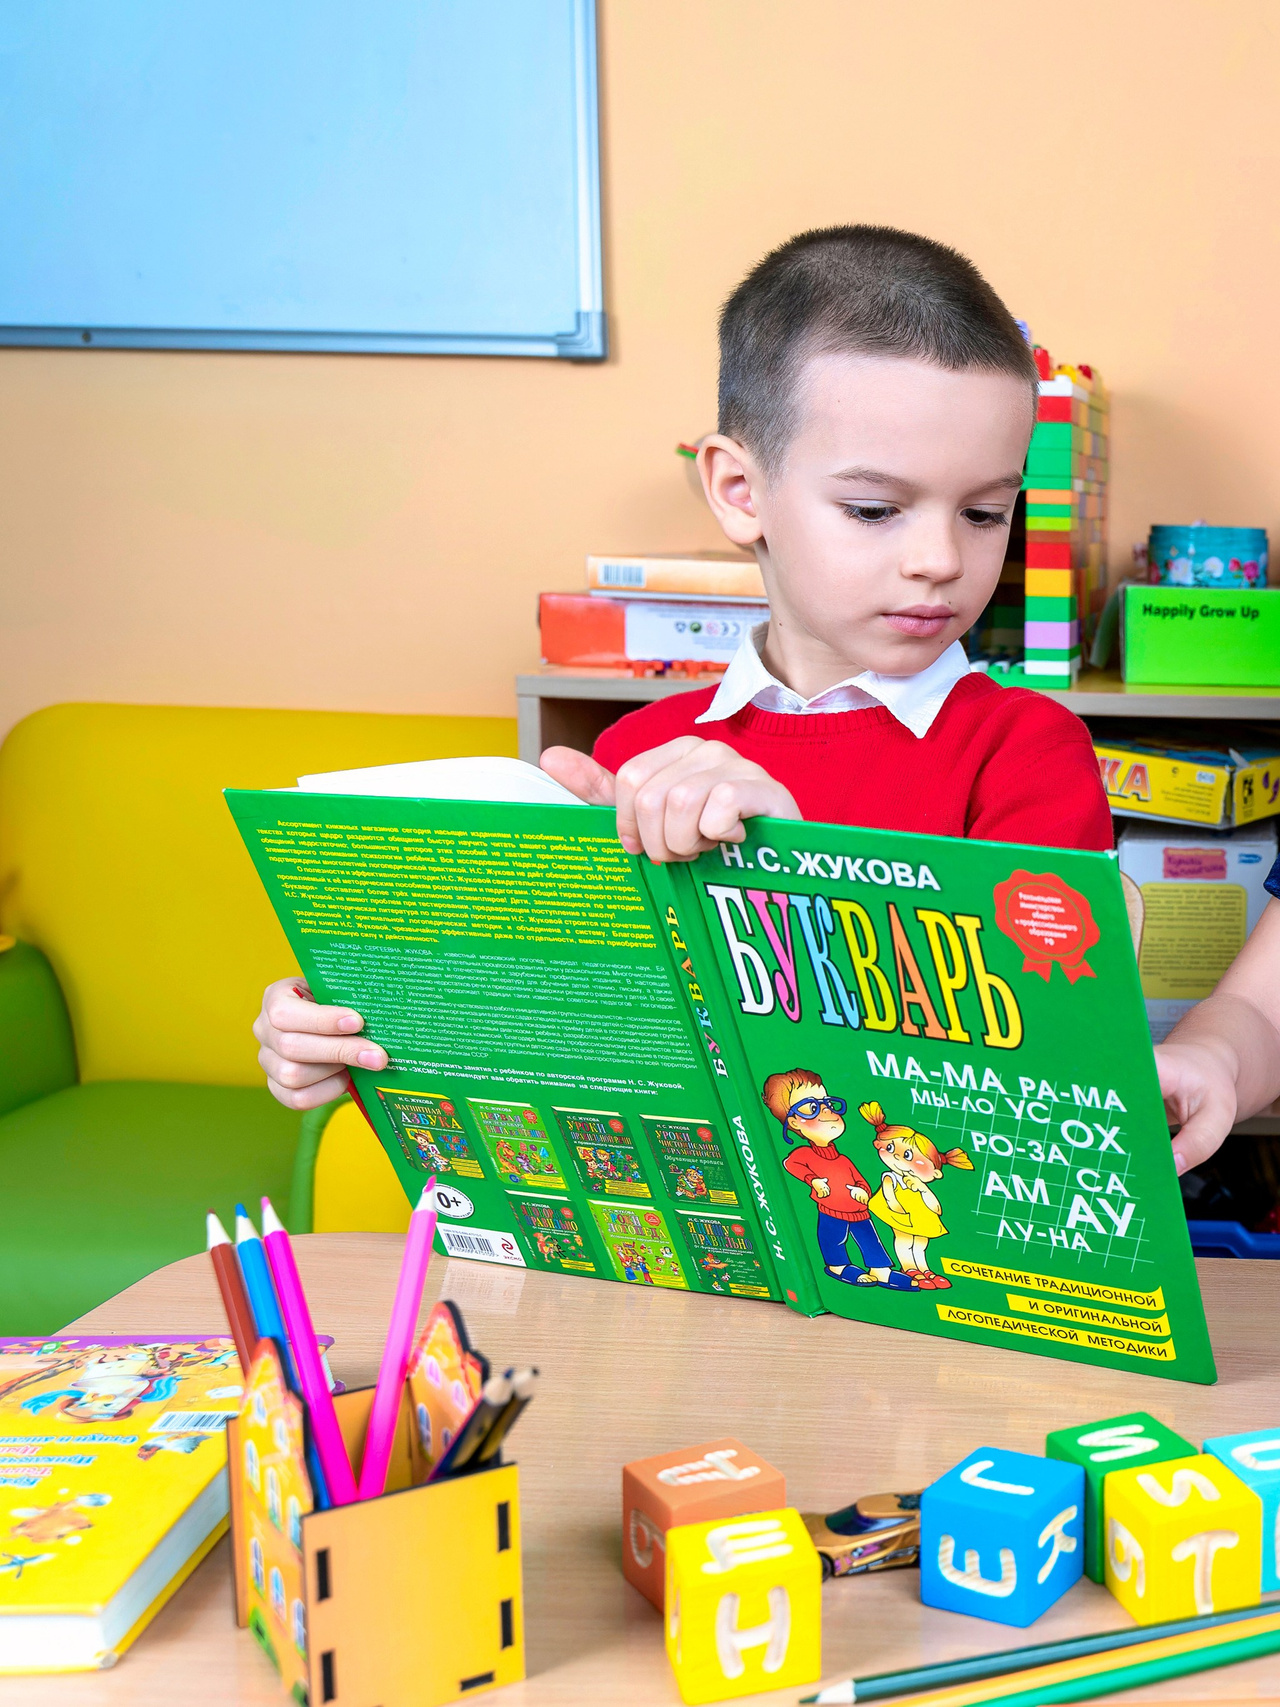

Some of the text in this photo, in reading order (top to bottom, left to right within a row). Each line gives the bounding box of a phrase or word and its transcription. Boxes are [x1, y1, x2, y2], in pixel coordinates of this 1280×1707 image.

[1142, 603, 1259, 620] Happily Grow Up
[277, 820, 322, 828] Ассортимент
[360, 825, 399, 833] магазинов
[401, 827, 432, 835] сегодня
[433, 829, 468, 837] насыщен
[522, 833, 567, 842] пособиями,
[577, 835, 623, 844] рекламных
[286, 830, 317, 838] которых
[319, 832, 343, 840] щедро
[387, 835, 424, 843] обещания
[426, 837, 455, 846] быстро
[549, 843, 584, 852] ребёнка.
[600, 845, 629, 854] одних
[721, 843, 942, 891] Н. С. ЖУКОВА
[1044, 938, 1055, 946] РФ
[706, 883, 1025, 1049] БУКВАРЬ
[665, 905, 730, 1080] БУКВАРЬ
[866, 1049, 1127, 1113] МА-МА РА-МА
[395, 1104, 441, 1115] МАГНИТНАЯ
[401, 1111, 462, 1129] АЗБУКА
[912, 1088, 1050, 1125] МЫ-ЛО УС
[566, 1120, 606, 1134] УРОКИ
[655, 1130, 691, 1142] УРОКИ
[971, 1119, 1126, 1167] РО-ЗА ОХ
[731, 1113, 775, 1207] ЖУКОВА
[437, 1192, 461, 1209] 0+
[985, 1166, 1129, 1206] АМ СА
[602, 1212, 641, 1227] УРОКИ
[608, 1222, 667, 1240] ЛОГОПЕДА
[764, 1216, 779, 1237] С.
[997, 1195, 1136, 1253] ЛУ-НА АУ
[691, 1234, 753, 1250] ПРАВИЛЬНО
[950, 1260, 1158, 1308] СОЧЕТАНИЕ ТРАДИЦИОННОЙ
[945, 1308, 1169, 1358] ЛОГОПЕДИЧЕСКОЙ МЕТОДИКИ
[1029, 1299, 1163, 1334] И ОРИГИНАЛЬНОЙ
[1171, 1529, 1240, 1615] Т
[716, 1585, 791, 1679] Н
